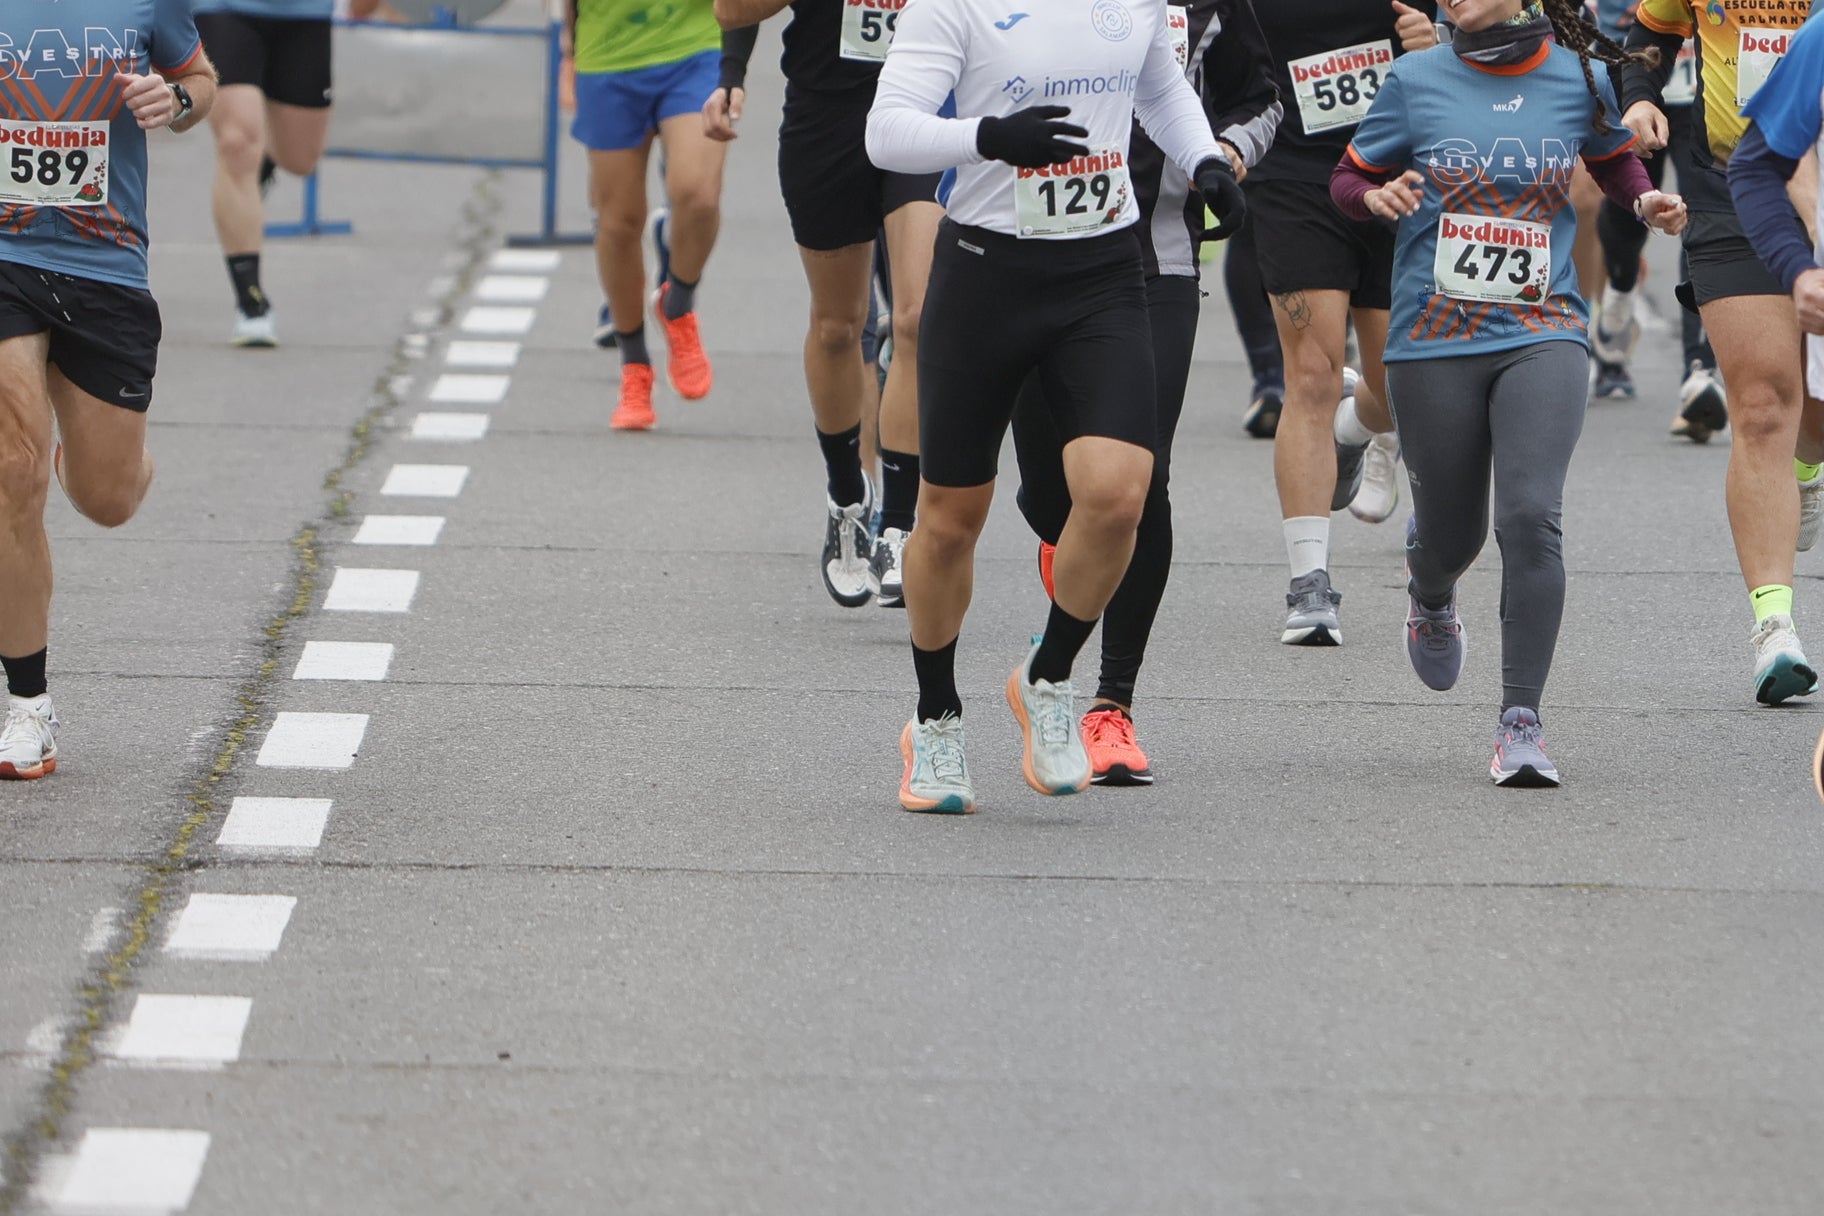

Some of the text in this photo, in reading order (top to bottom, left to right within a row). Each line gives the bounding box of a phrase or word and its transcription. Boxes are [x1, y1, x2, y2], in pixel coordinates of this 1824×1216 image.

[1724, 0, 1785, 10] ESCUELA
[1742, 32, 1788, 55] bed
[1292, 47, 1391, 84] bedunia
[1312, 69, 1381, 112] 583
[10, 147, 89, 186] 589
[1038, 174, 1111, 217] 129
[1441, 218, 1548, 249] bedunia
[1453, 244, 1533, 285] 473
